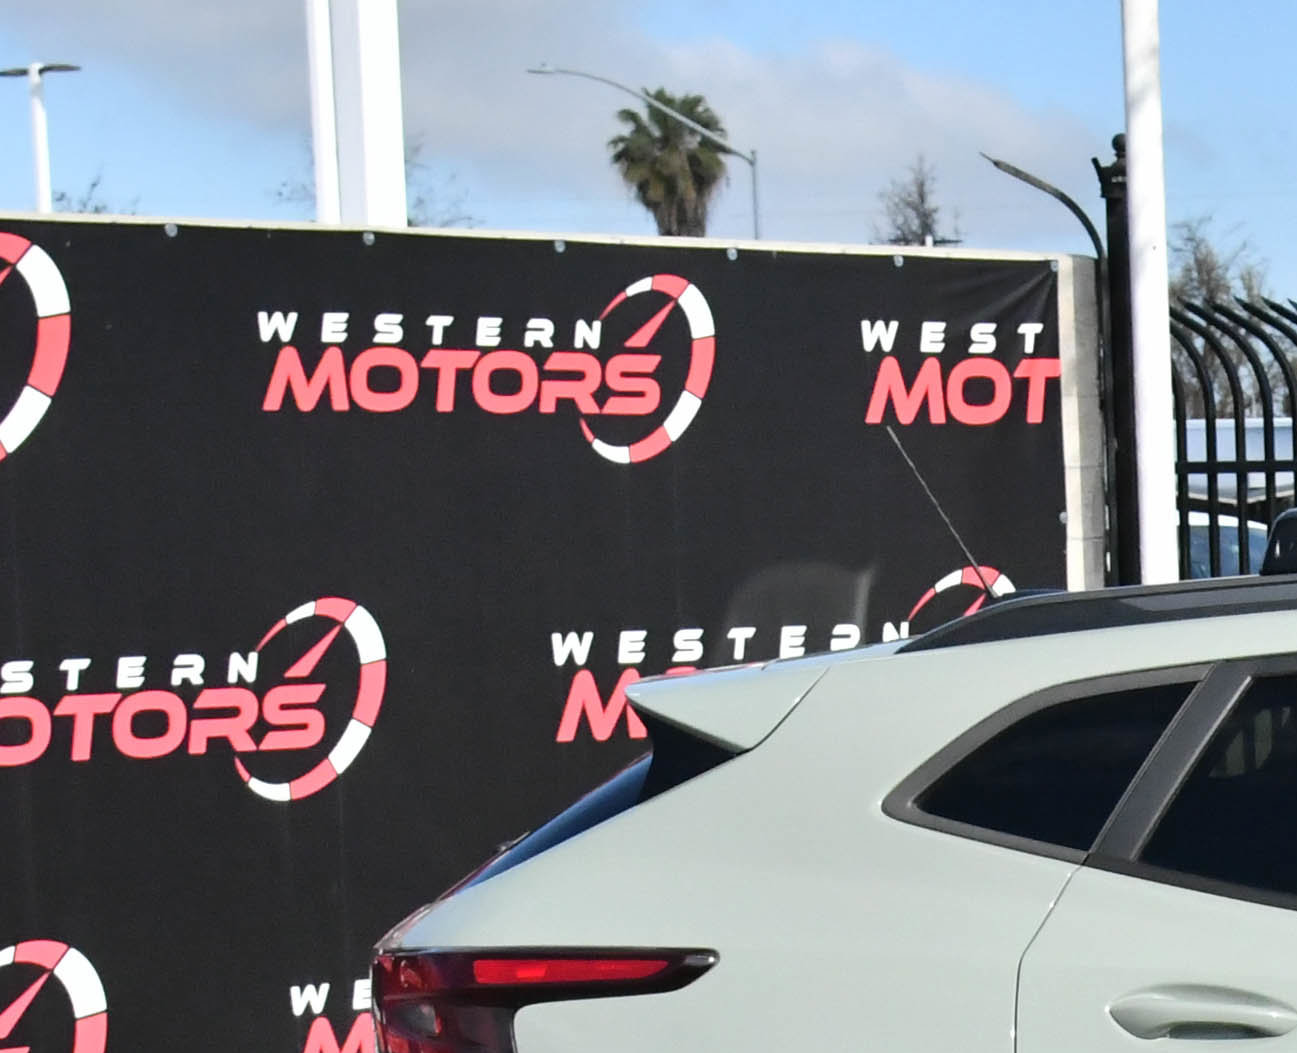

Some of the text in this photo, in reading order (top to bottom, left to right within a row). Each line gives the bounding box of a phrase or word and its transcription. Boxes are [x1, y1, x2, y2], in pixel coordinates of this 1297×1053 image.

[258, 311, 602, 349] WESTERN
[861, 319, 1044, 353] WEST
[262, 345, 662, 415] MOTORS
